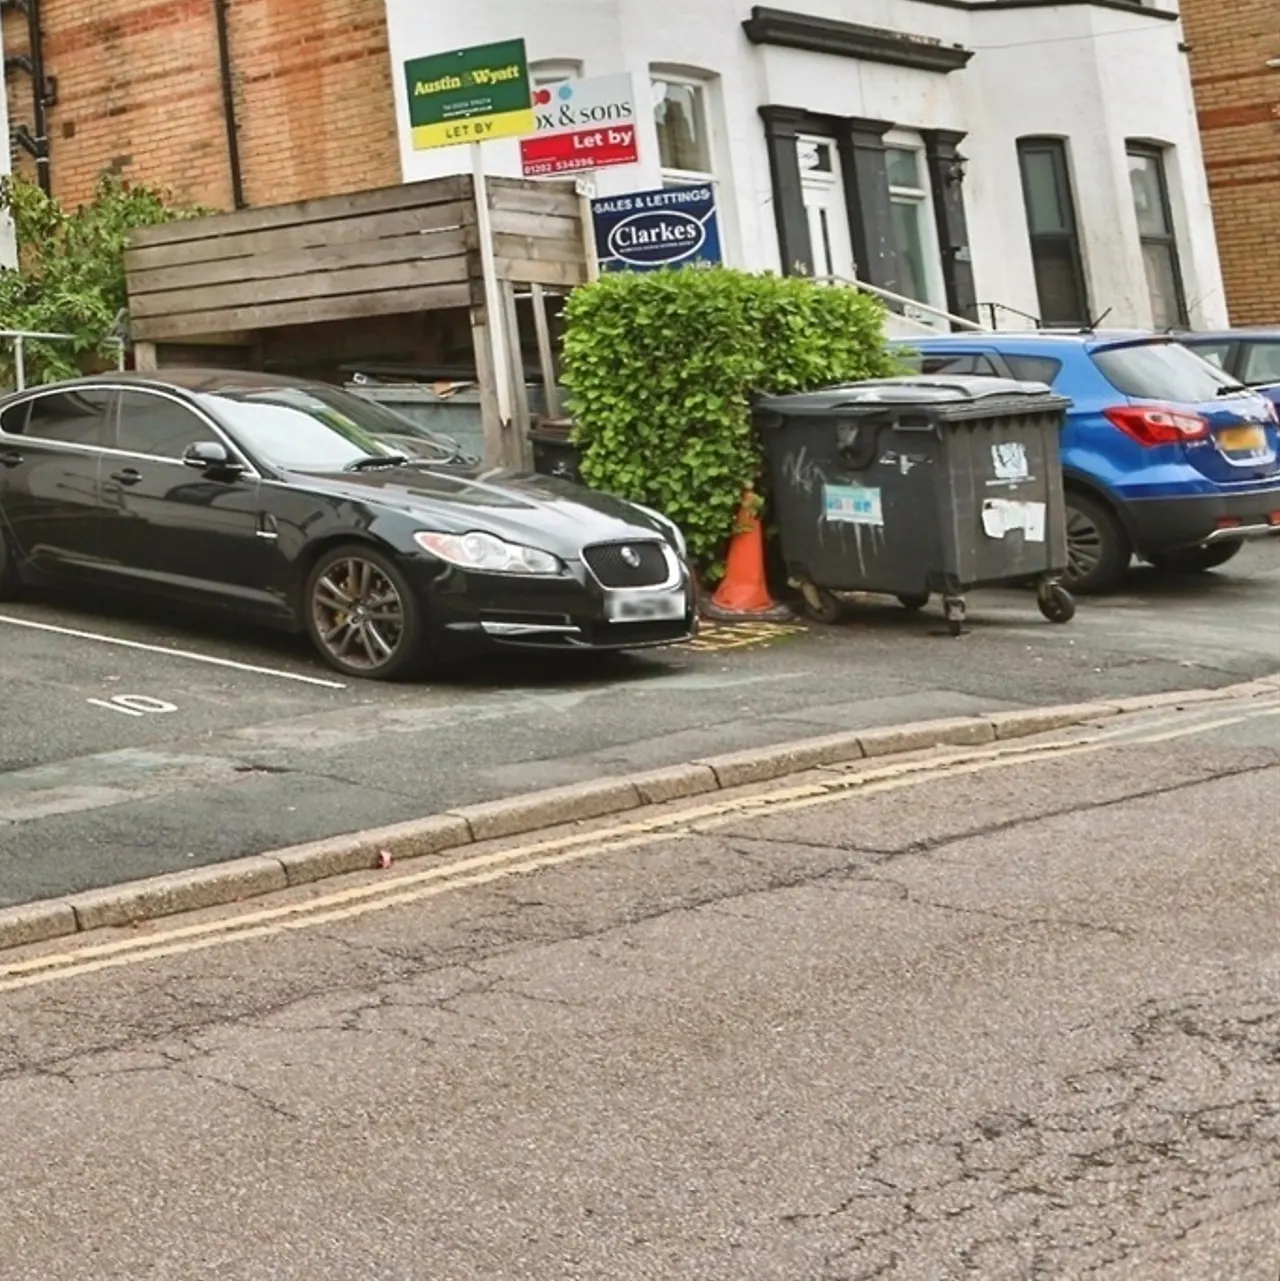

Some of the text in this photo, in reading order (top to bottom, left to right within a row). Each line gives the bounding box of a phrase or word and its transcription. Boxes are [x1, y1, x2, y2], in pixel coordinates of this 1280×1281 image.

[414, 75, 461, 96] Austin
[471, 64, 519, 85] Wyatt
[558, 103, 576, 127] &
[579, 101, 633, 123] sons
[445, 122, 493, 139] LET BY
[572, 129, 633, 149] Let by
[593, 188, 711, 214] SALES & LETTINGS
[615, 222, 697, 247] Clarkes
